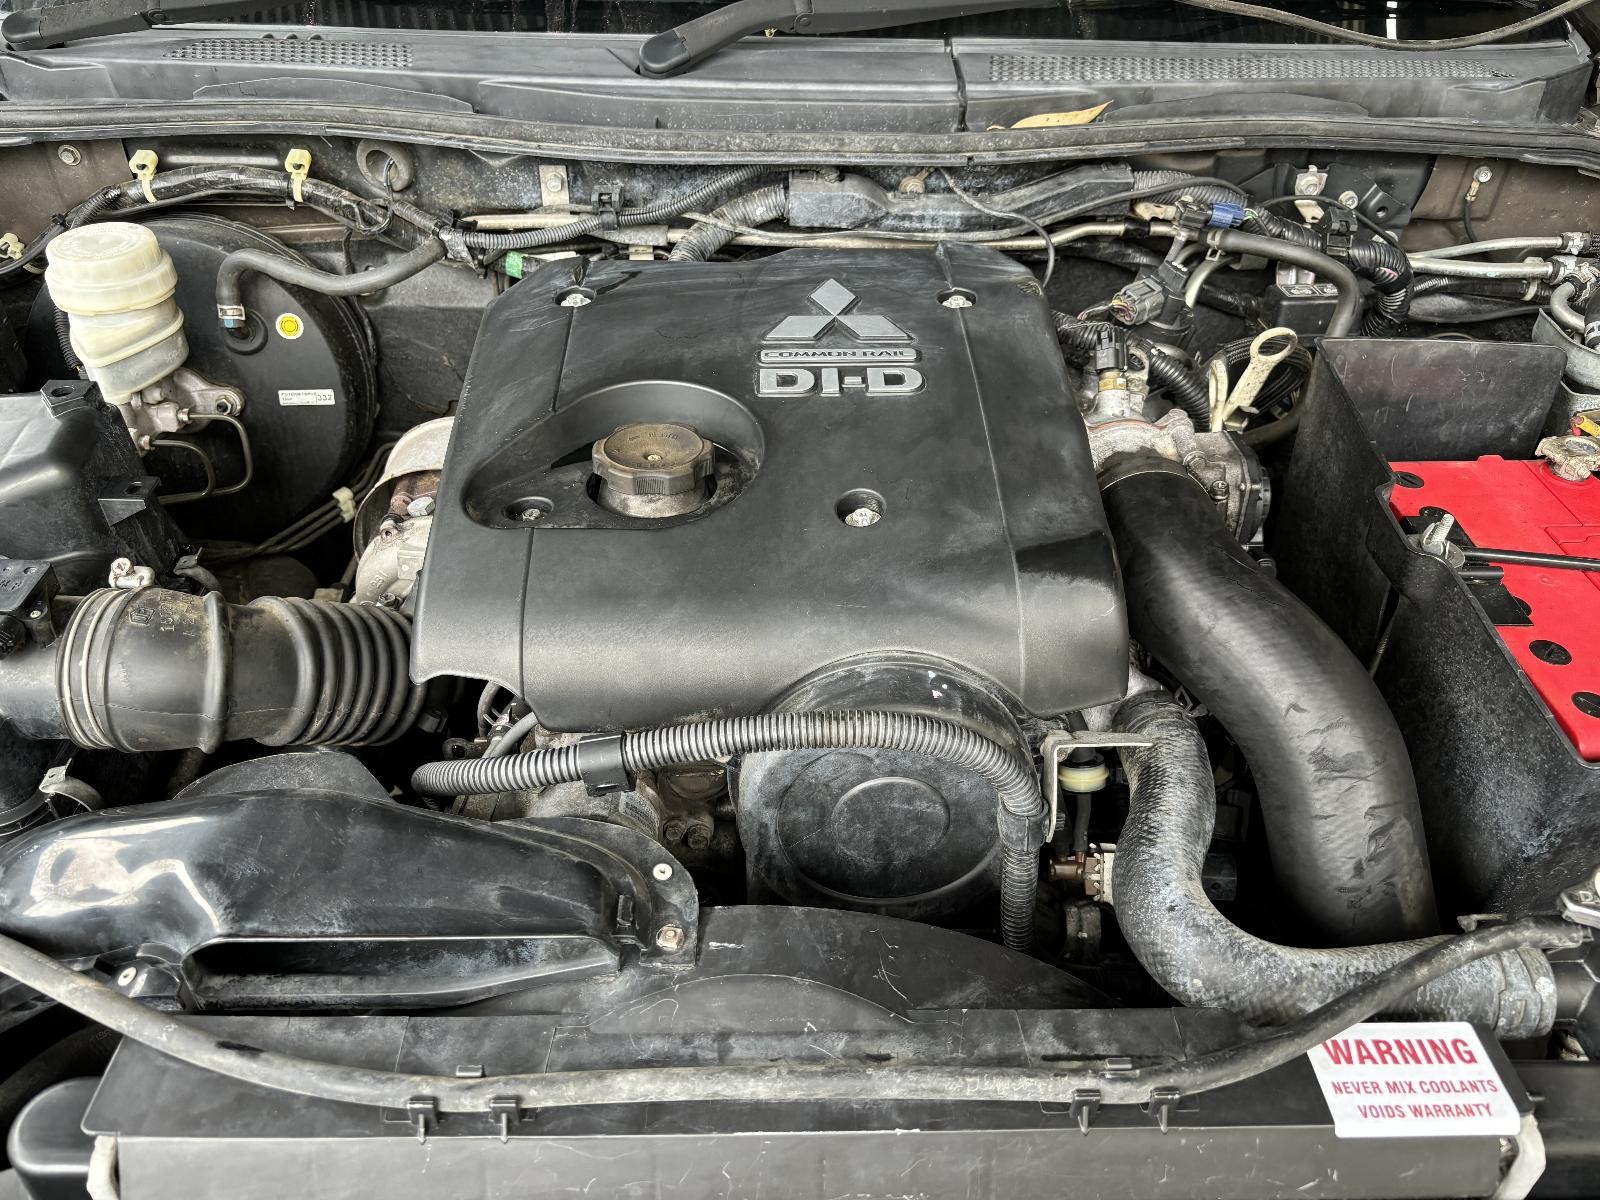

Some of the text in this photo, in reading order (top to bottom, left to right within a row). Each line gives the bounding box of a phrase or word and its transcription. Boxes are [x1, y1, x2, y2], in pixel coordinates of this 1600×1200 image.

[759, 367, 923, 395] DI-D
[1322, 1038, 1478, 1065] WARNING
[1331, 1079, 1498, 1095] NEVER MIX COOLANTS
[1357, 1103, 1493, 1119] VOIDS WARRANTY
